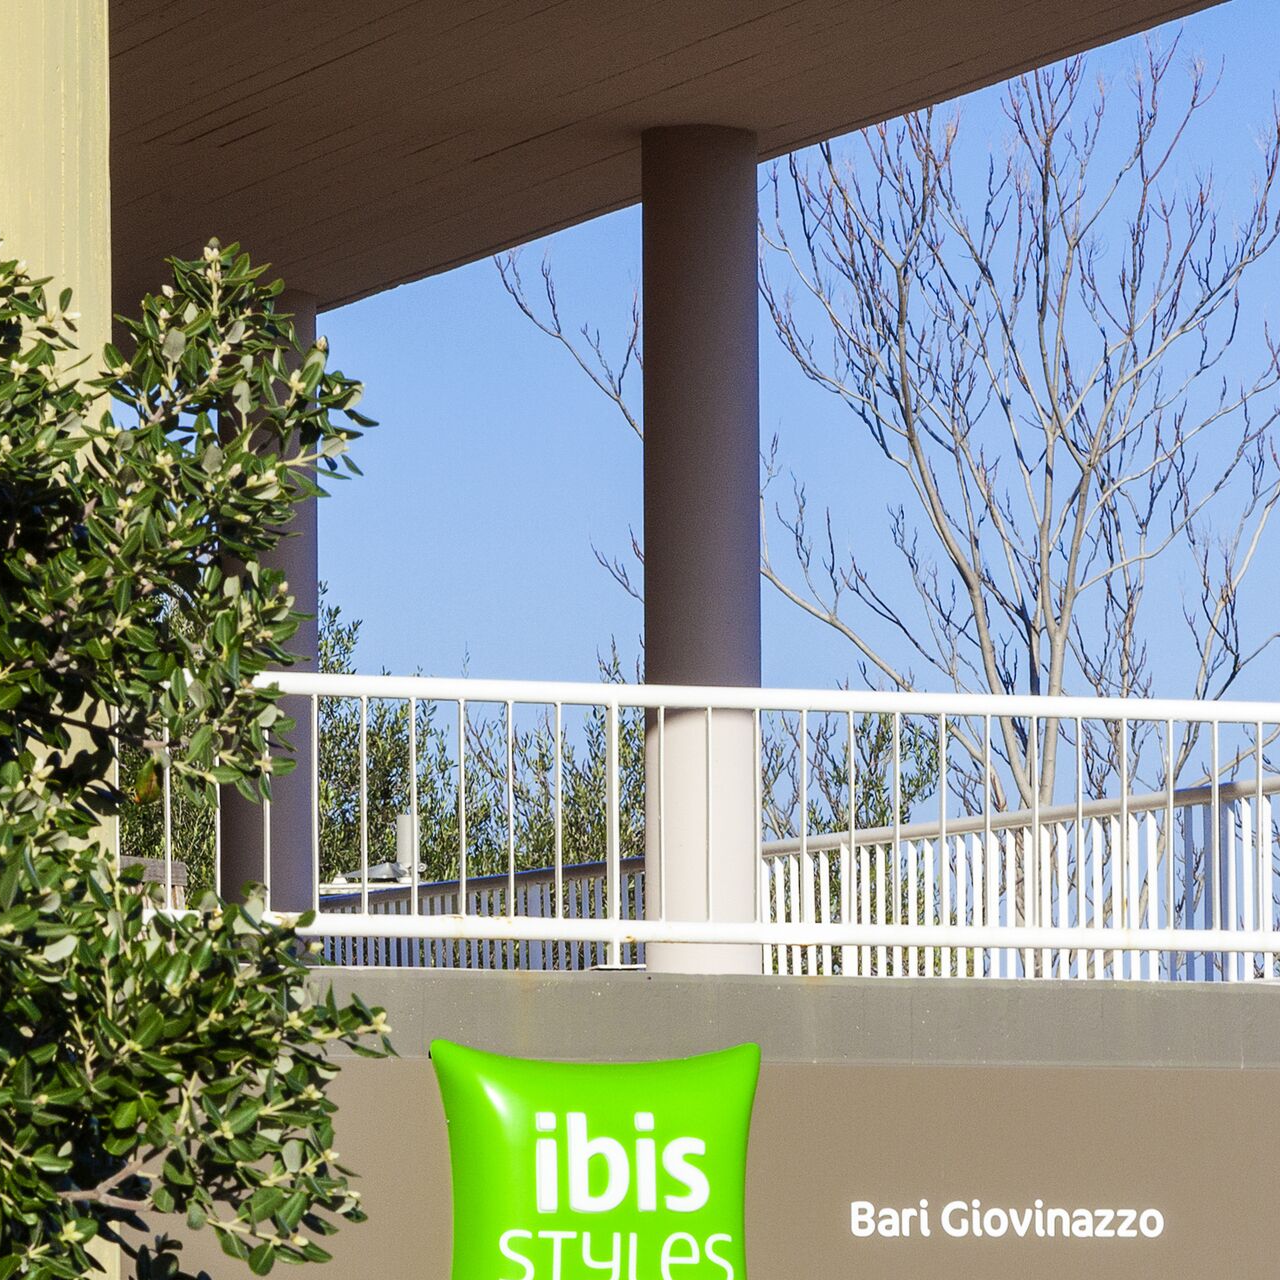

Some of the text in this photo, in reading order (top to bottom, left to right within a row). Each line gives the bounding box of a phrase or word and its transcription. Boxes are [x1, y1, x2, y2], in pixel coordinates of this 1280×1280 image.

[534, 1110, 710, 1214] ibis
[850, 1198, 1165, 1239] Bari Giovinazzo
